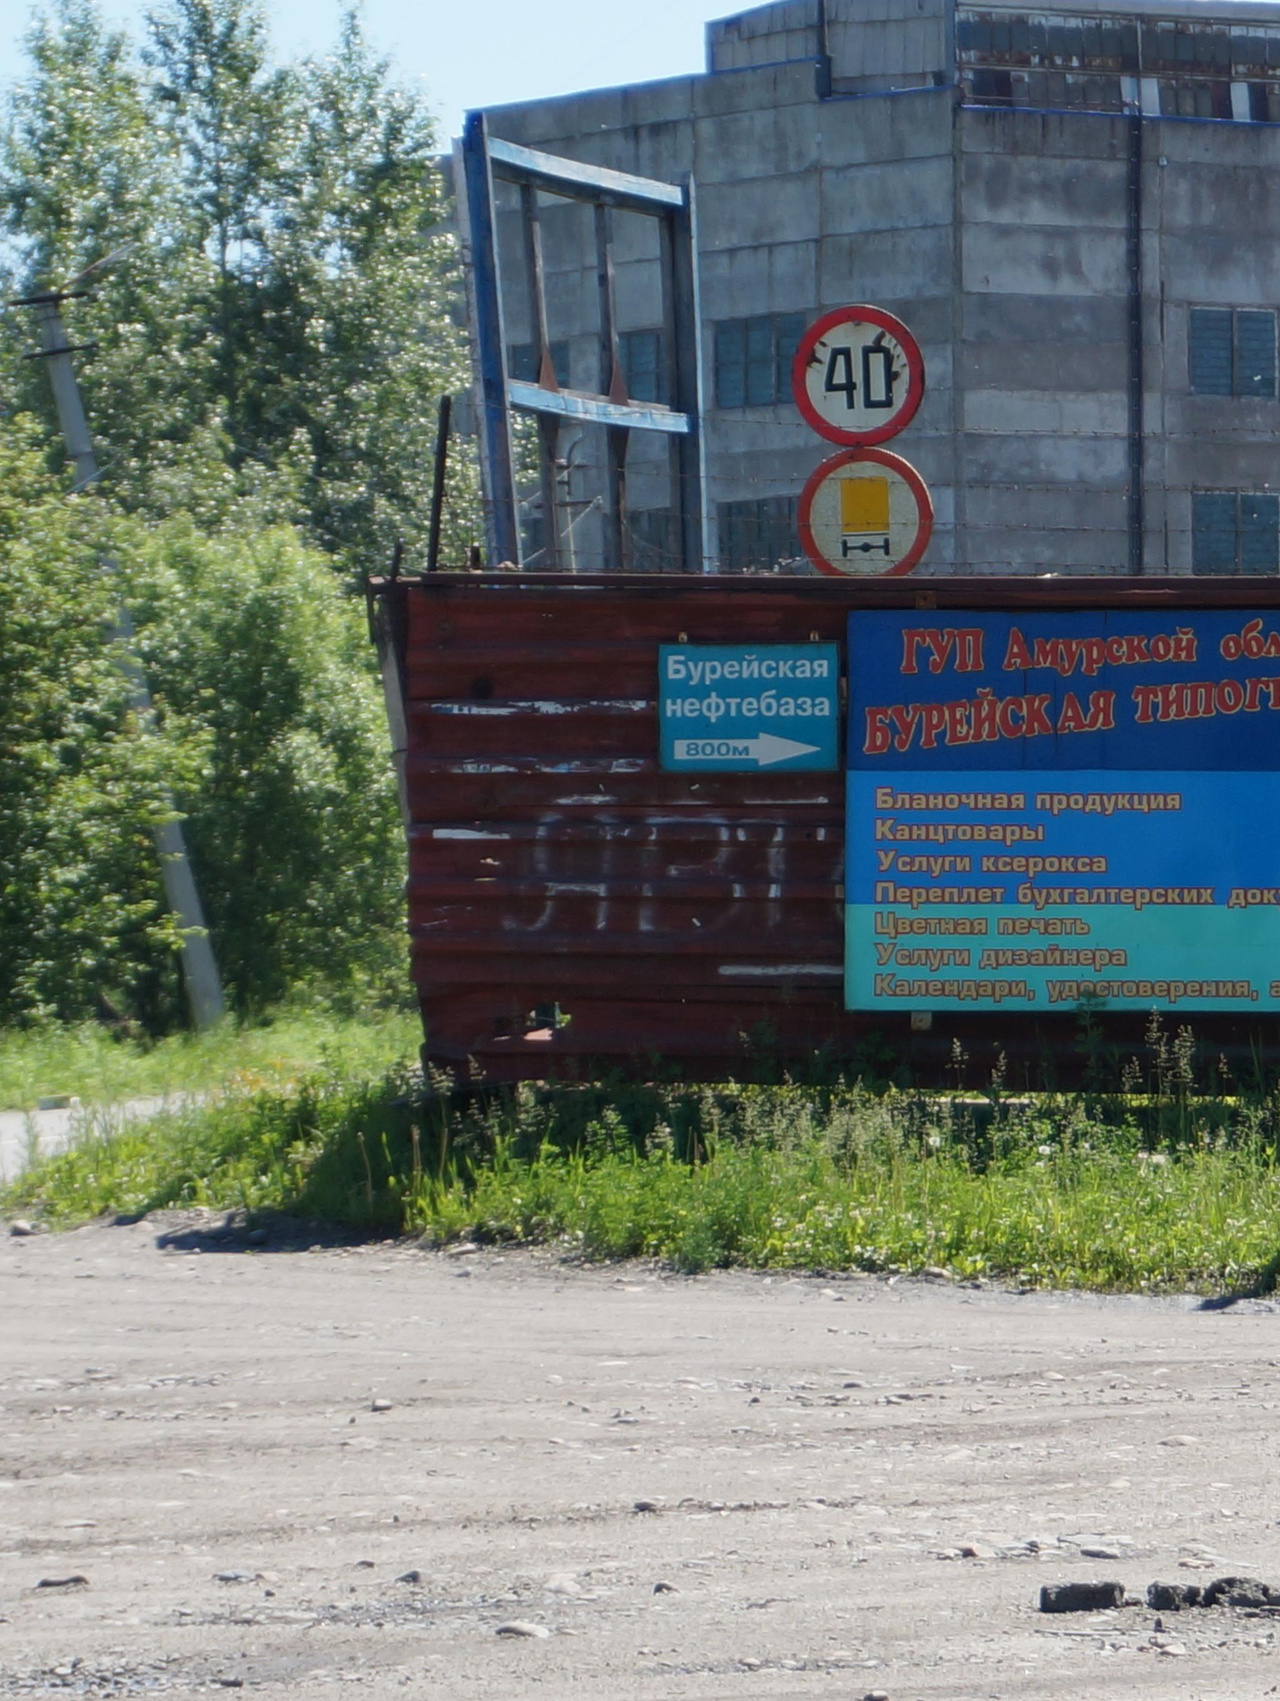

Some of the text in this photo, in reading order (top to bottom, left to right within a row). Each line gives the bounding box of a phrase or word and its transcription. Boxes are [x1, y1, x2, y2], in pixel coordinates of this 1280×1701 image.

[824, 344, 894, 410] 40
[900, 628, 984, 674] ГУП
[1003, 626, 1198, 677] Амурской
[666, 654, 829, 686] Бурейская
[665, 689, 831, 723] нефтебаза
[862, 688, 1116, 754] БУРЕЙСКАЯ
[685, 742, 750, 757] 800м
[874, 787, 1181, 815] Бланочная продукция
[874, 819, 1044, 846] Канцтовары
[877, 850, 1107, 877] Услуги ксерокса
[874, 882, 1005, 909] Переплет
[1016, 883, 1214, 909] бухгалтерских
[874, 912, 1090, 938] Цветная печать
[874, 943, 1127, 970] Услуги дизайнера
[874, 974, 1035, 1001] Календари,
[1046, 978, 1259, 1003] удостоверения,
